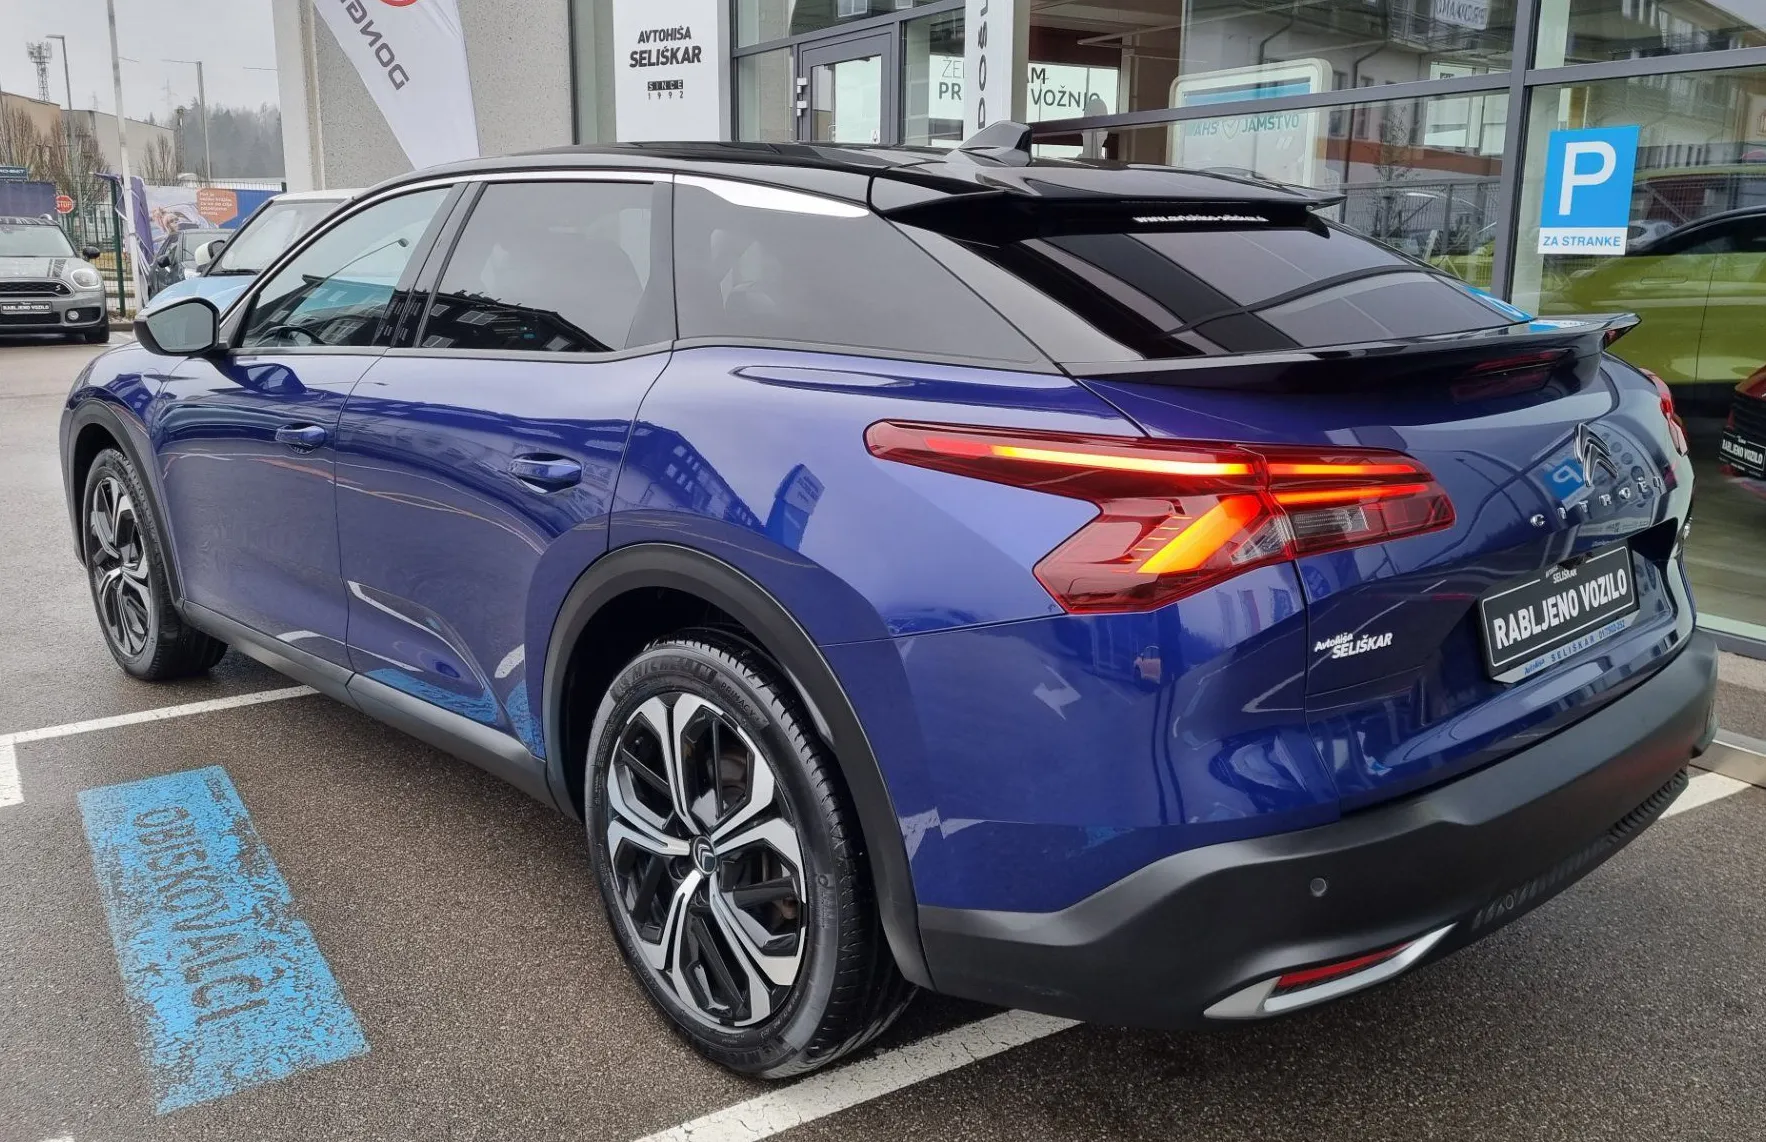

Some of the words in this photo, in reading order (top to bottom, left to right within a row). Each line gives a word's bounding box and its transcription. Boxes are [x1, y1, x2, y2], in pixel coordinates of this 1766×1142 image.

[637, 25, 692, 44] AVTOHIŠA
[629, 46, 702, 68] SELIŠKAR
[648, 80, 684, 91] SINCE
[648, 90, 684, 100] 1992
[938, 82, 963, 101] PR
[1242, 114, 1300, 133] JAMSTVO
[1558, 140, 1617, 216] P
[57, 200, 72, 209] STOP
[1543, 236, 1559, 247] ZA
[1562, 235, 1622, 247] STRANKE
[1493, 588, 1580, 650] RABLJENO
[1579, 568, 1628, 612] VOZILO
[1331, 632, 1394, 659] SELIŠKAR
[720, 681, 756, 718] PRIMACY
[133, 805, 270, 1025] OBISKOVALCI
